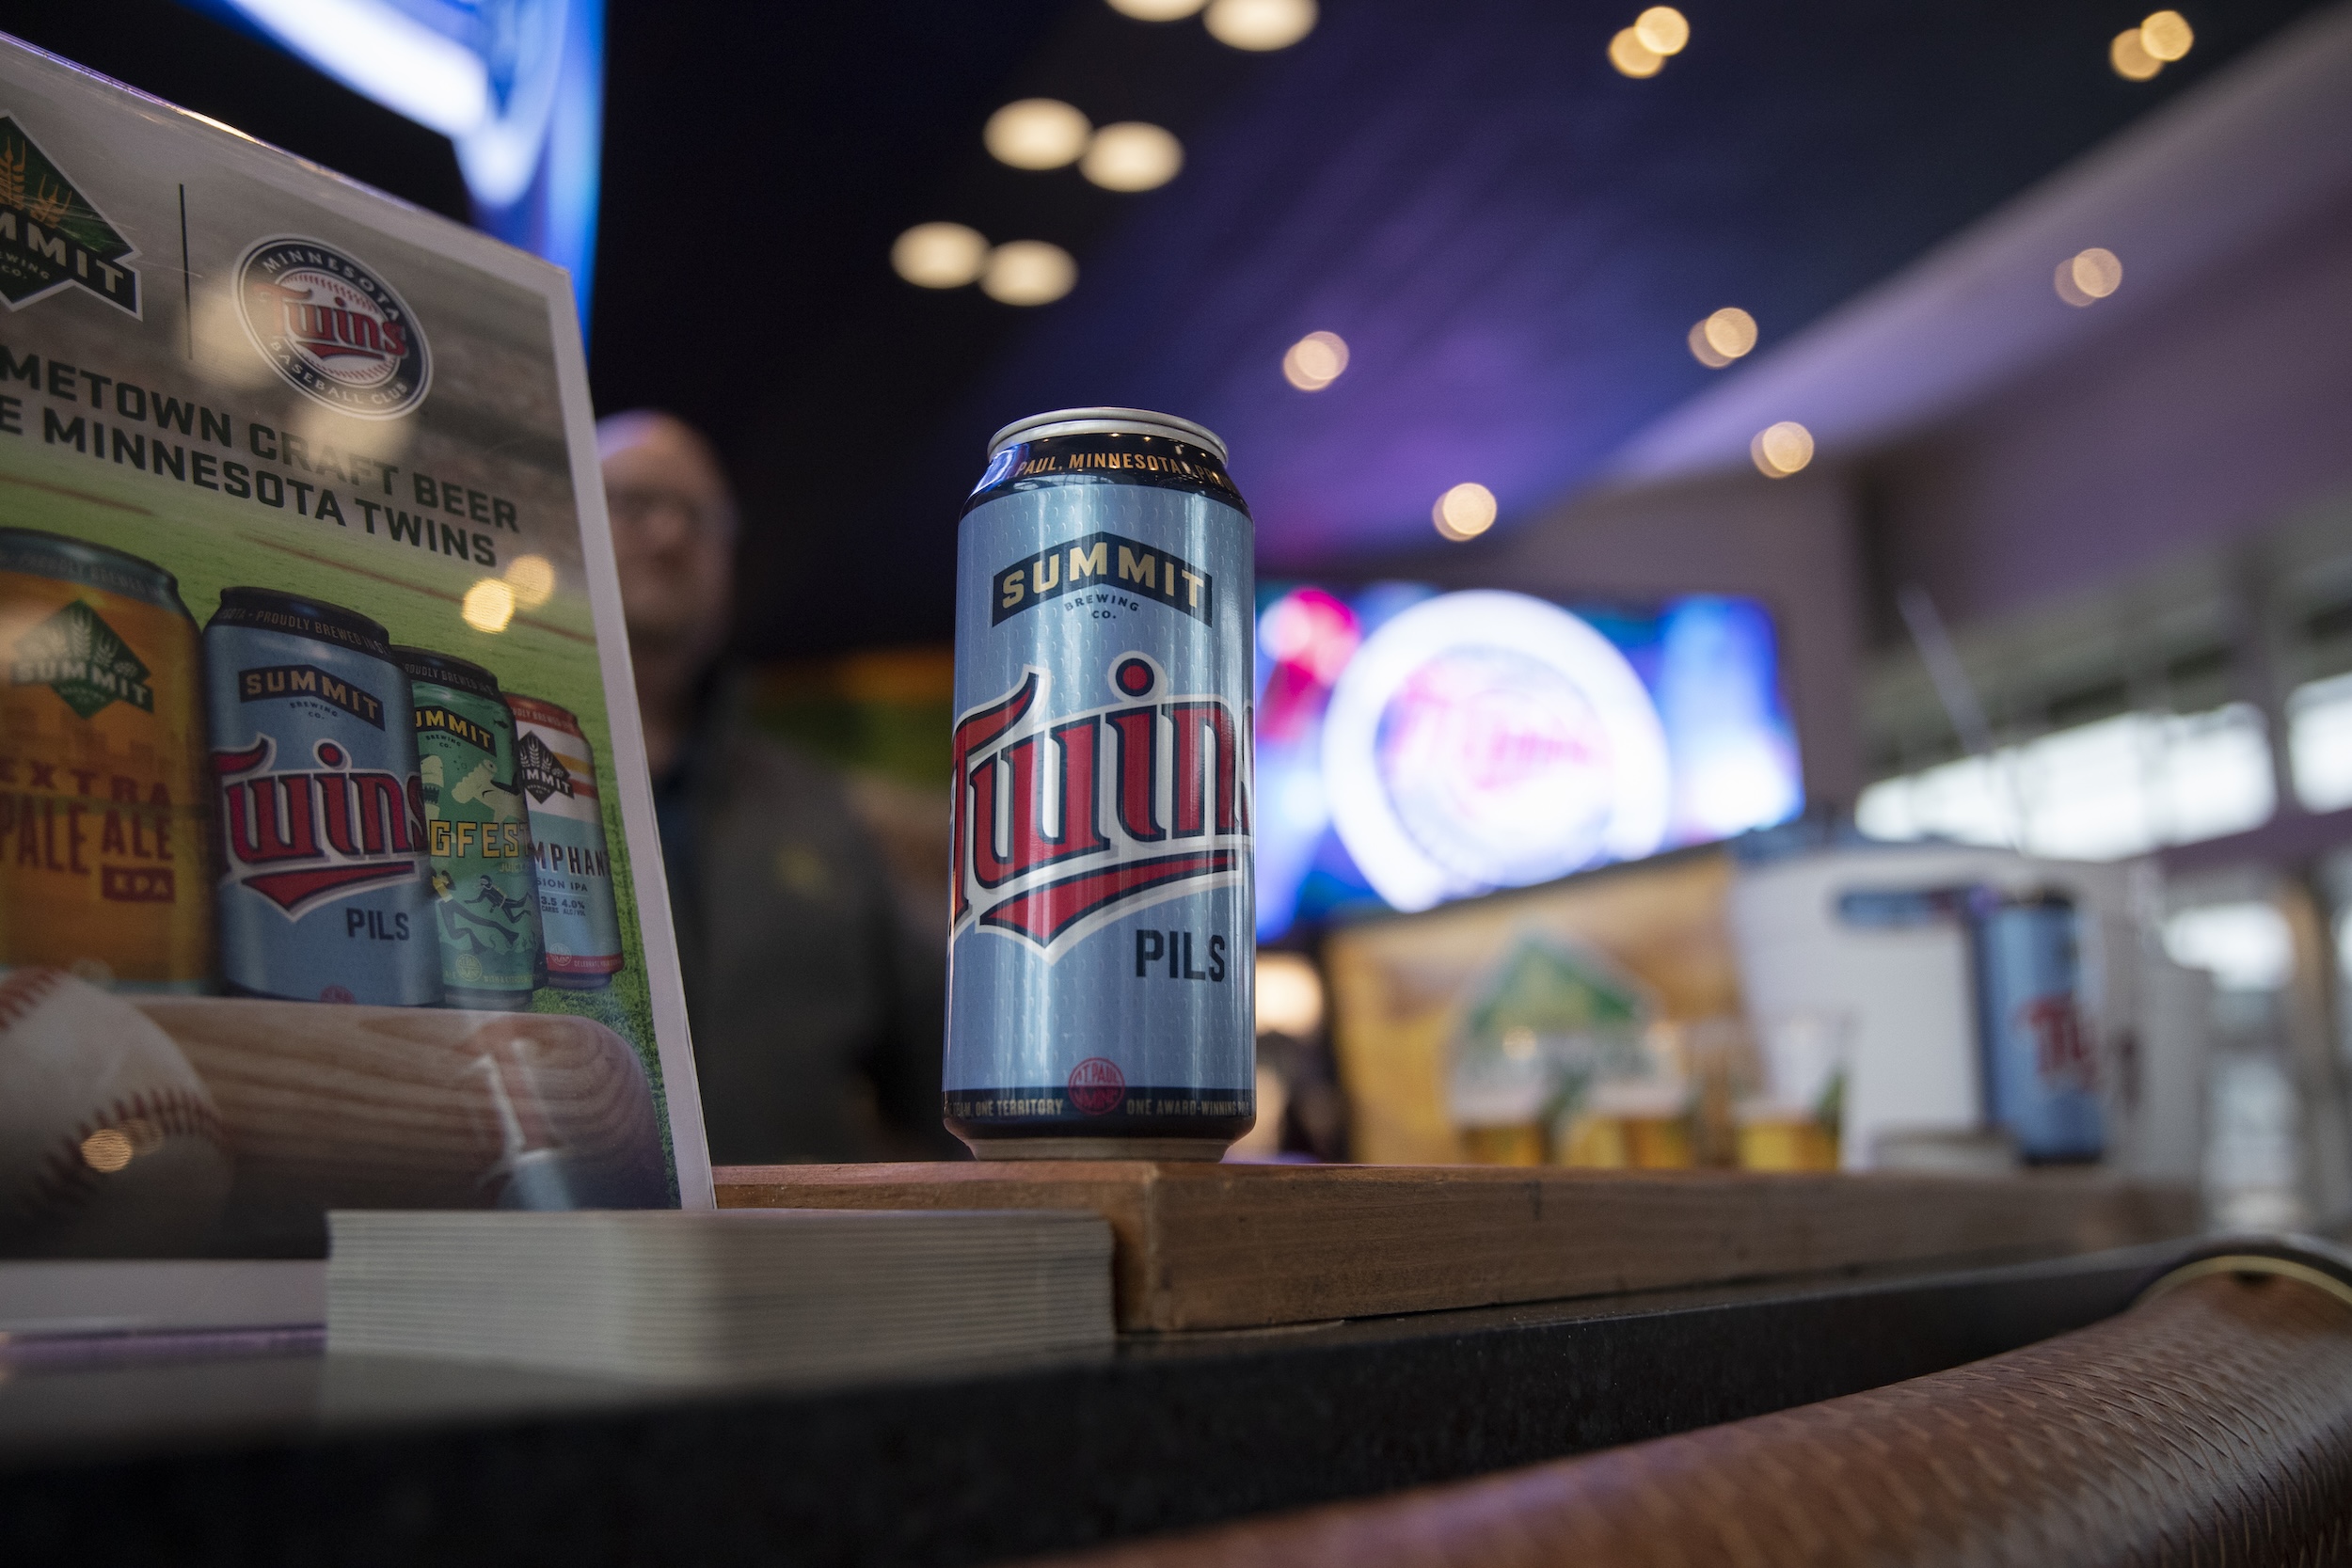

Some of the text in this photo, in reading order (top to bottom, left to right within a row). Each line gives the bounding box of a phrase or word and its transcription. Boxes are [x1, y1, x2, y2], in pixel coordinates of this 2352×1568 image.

[262, 248, 401, 321] MINNESOTA
[252, 282, 407, 358] Twins
[269, 340, 408, 405] BASEBALL CLUB
[248, 423, 399, 496] CRAFT
[413, 471, 520, 533] BEER
[1013, 452, 1184, 478] PAUL, MINNESOTA
[43, 406, 347, 527] MINNESOTA
[355, 498, 498, 568] TWINS
[1002, 542, 1205, 610] SUMMIT
[1063, 593, 1140, 611] BREWING
[1091, 610, 1117, 619] CO.
[256, 611, 310, 631] PROUDLY
[314, 622, 362, 645] BREWED
[246, 670, 378, 720] SUMMIT
[290, 702, 339, 718] BREWING
[101, 809, 174, 861] ALE
[540, 895, 586, 910] 3.5 4.0%
[570, 881, 589, 892] IPA
[345, 907, 410, 941] PILS
[1136, 928, 1226, 983] PILS
[976, 1101, 993, 1117] ONE
[997, 1099, 1064, 1116] TERRITORY
[1126, 1099, 1152, 1116] ONE
